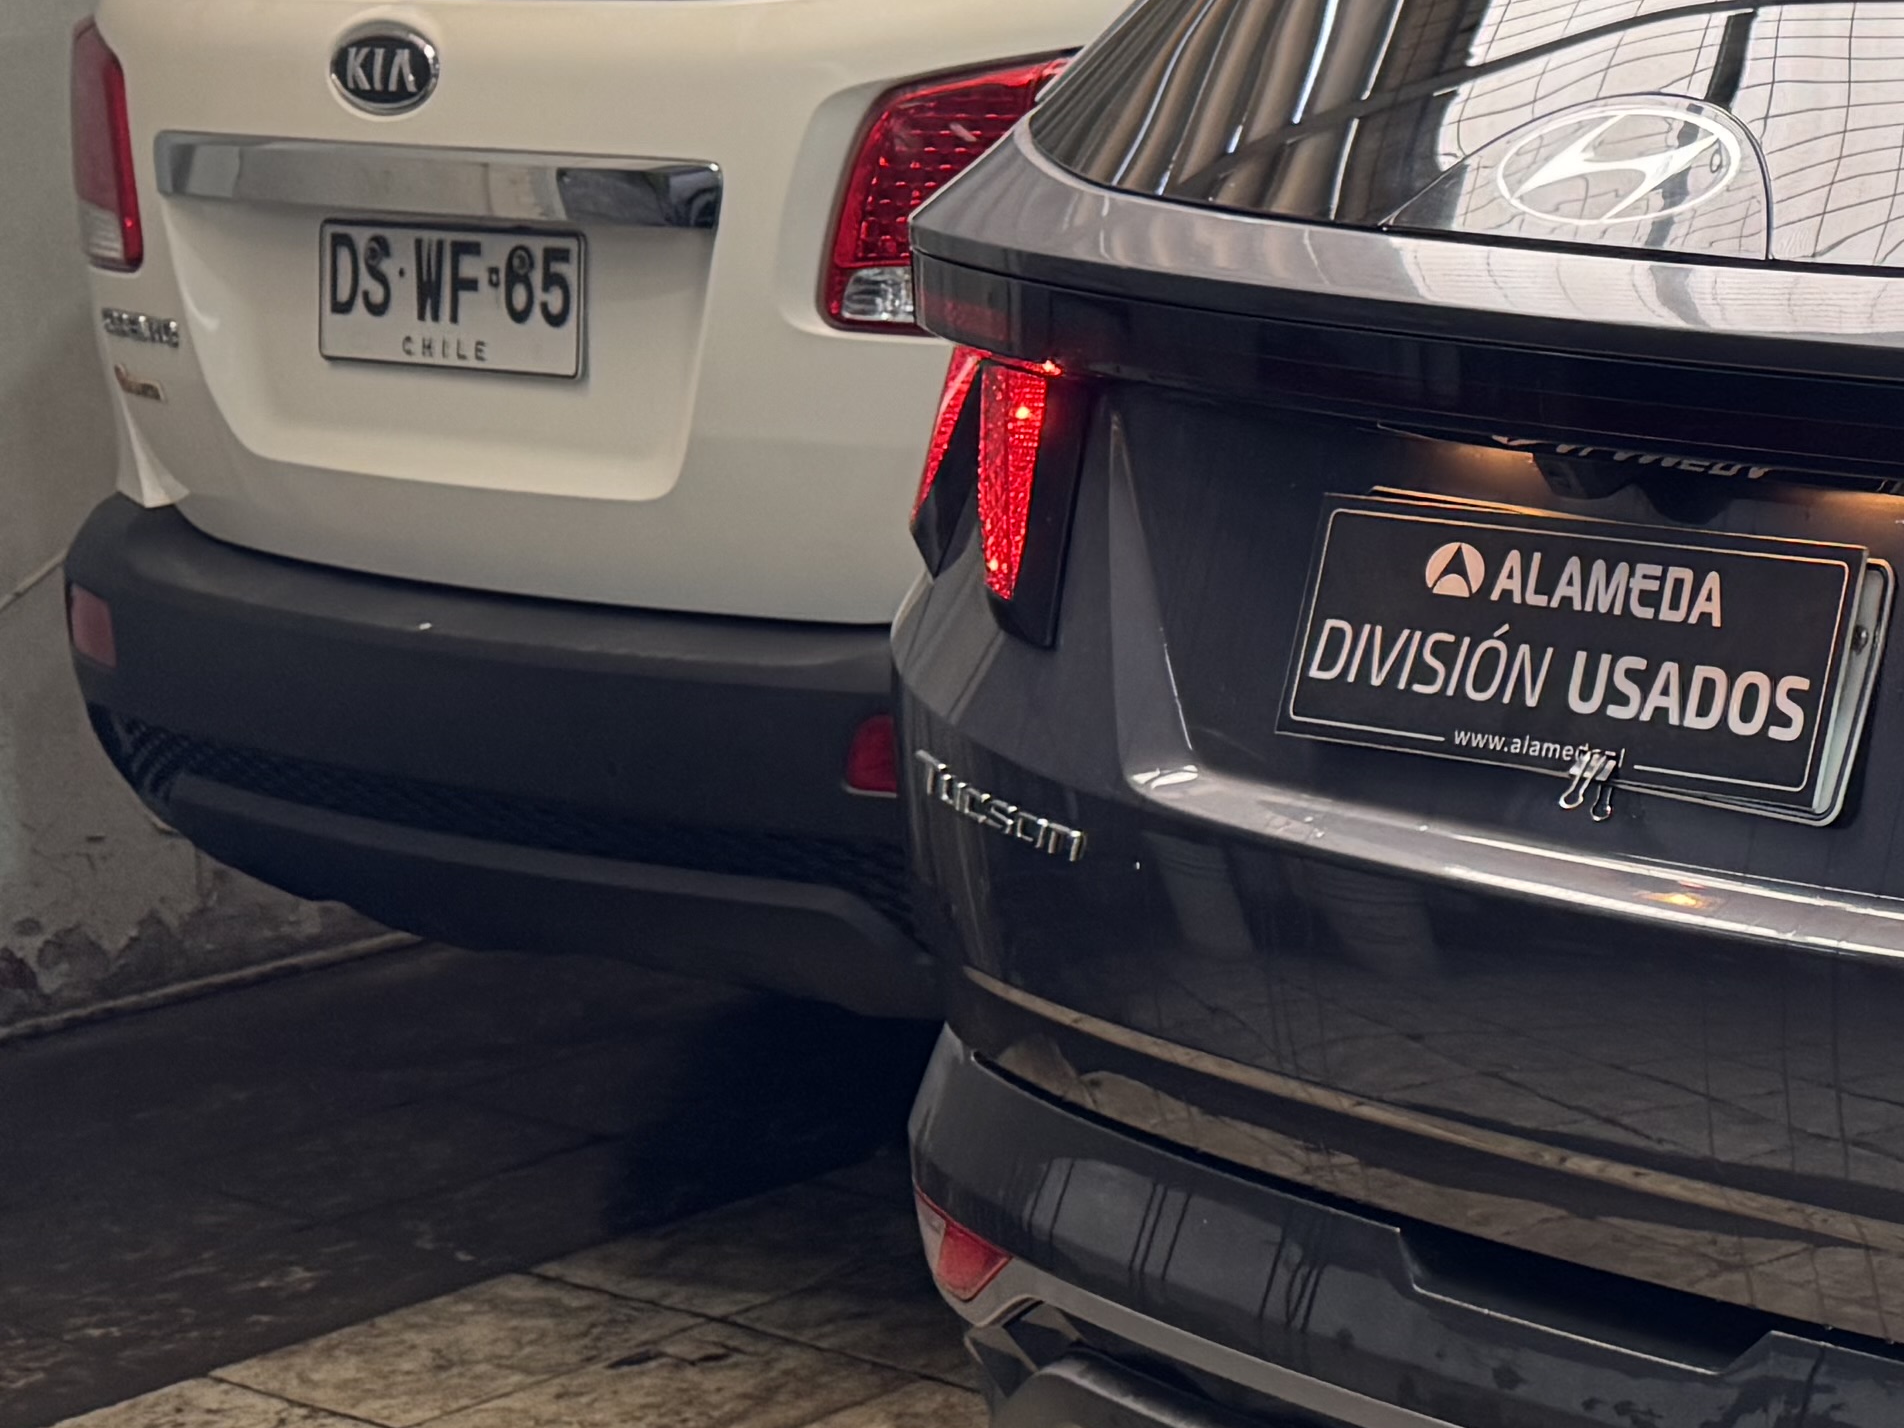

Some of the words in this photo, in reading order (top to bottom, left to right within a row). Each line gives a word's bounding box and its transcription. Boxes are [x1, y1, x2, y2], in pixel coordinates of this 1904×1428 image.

[345, 46, 418, 92] KIA
[402, 335, 487, 362] CHILE
[1490, 549, 1723, 628] ALAMEDA
[1308, 618, 1554, 708] DIVISIÓN
[1567, 649, 1811, 742] USADOS
